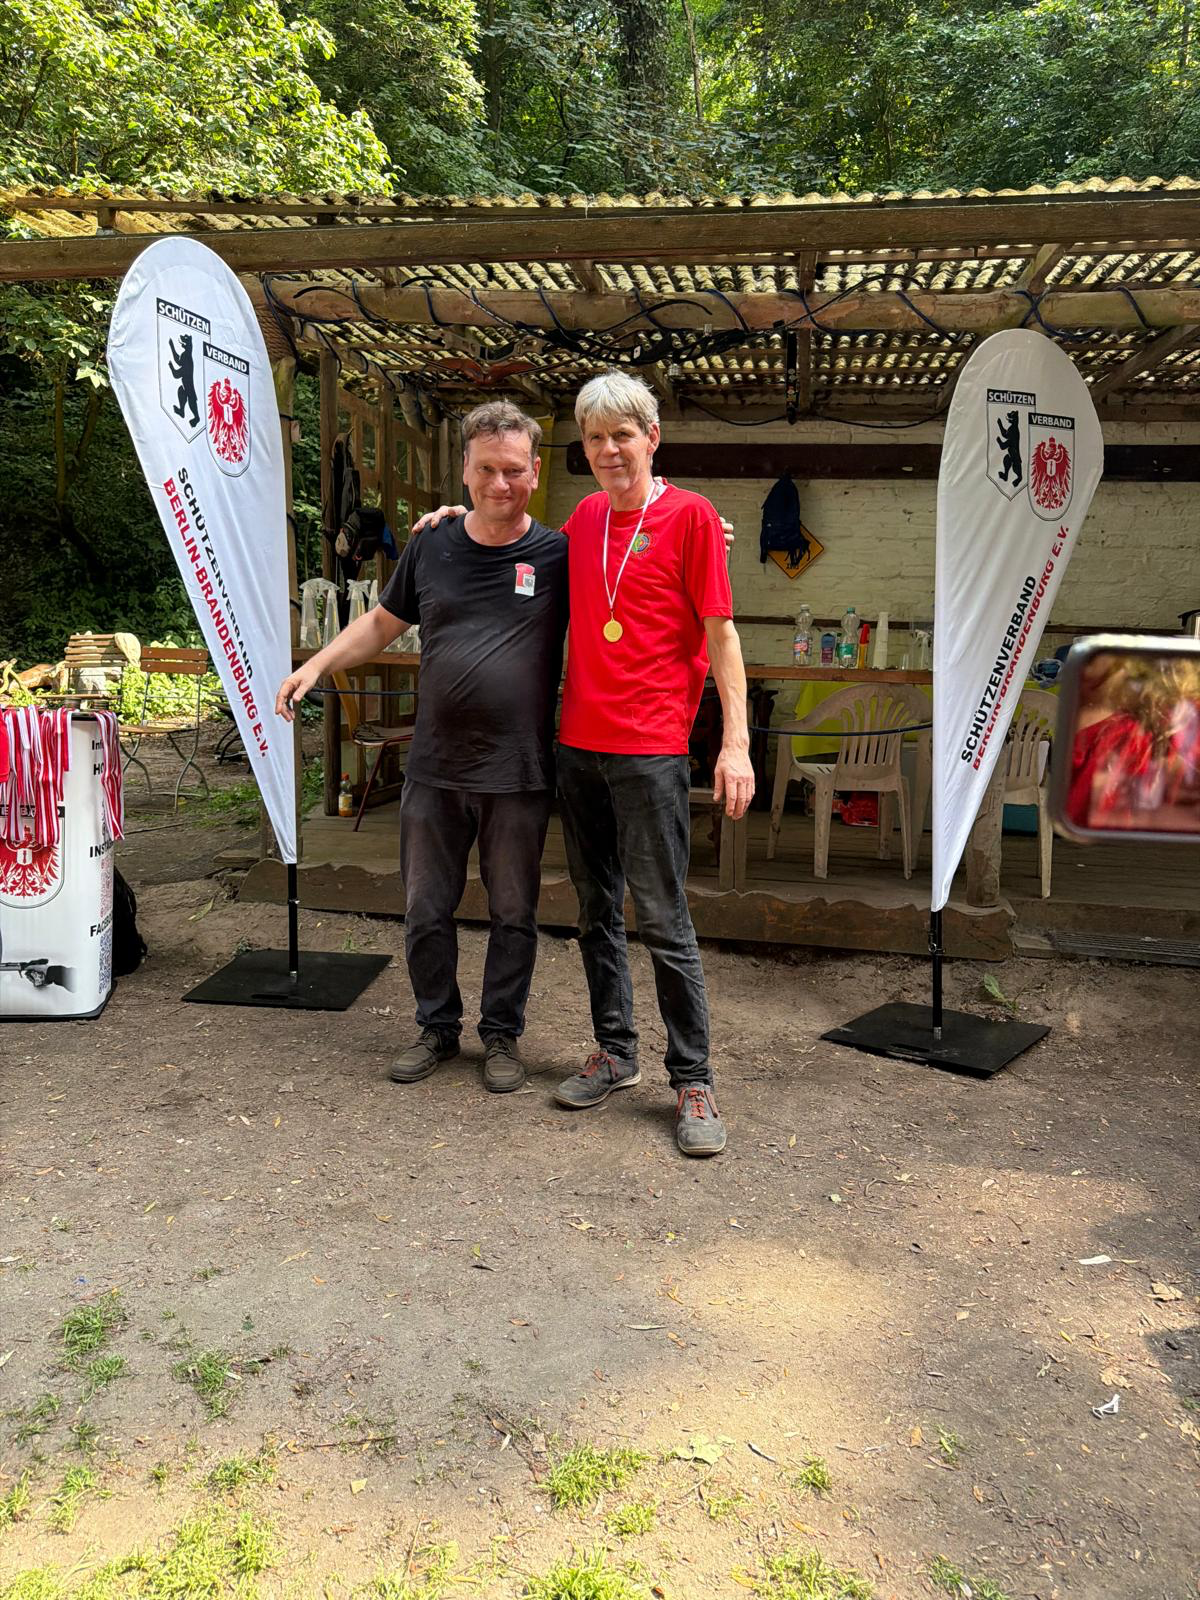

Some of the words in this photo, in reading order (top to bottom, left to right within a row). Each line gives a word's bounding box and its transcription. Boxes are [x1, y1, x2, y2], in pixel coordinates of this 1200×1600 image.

[158, 302, 209, 333] SCHÜTZEN
[206, 345, 247, 373] VERBAND
[988, 391, 1035, 405] SCHÜTZEN
[1031, 414, 1072, 428] VERBAND
[163, 477, 259, 721] BERLIN-BRANDENBURG
[961, 575, 1037, 763] SCHÜTZENVERBAND
